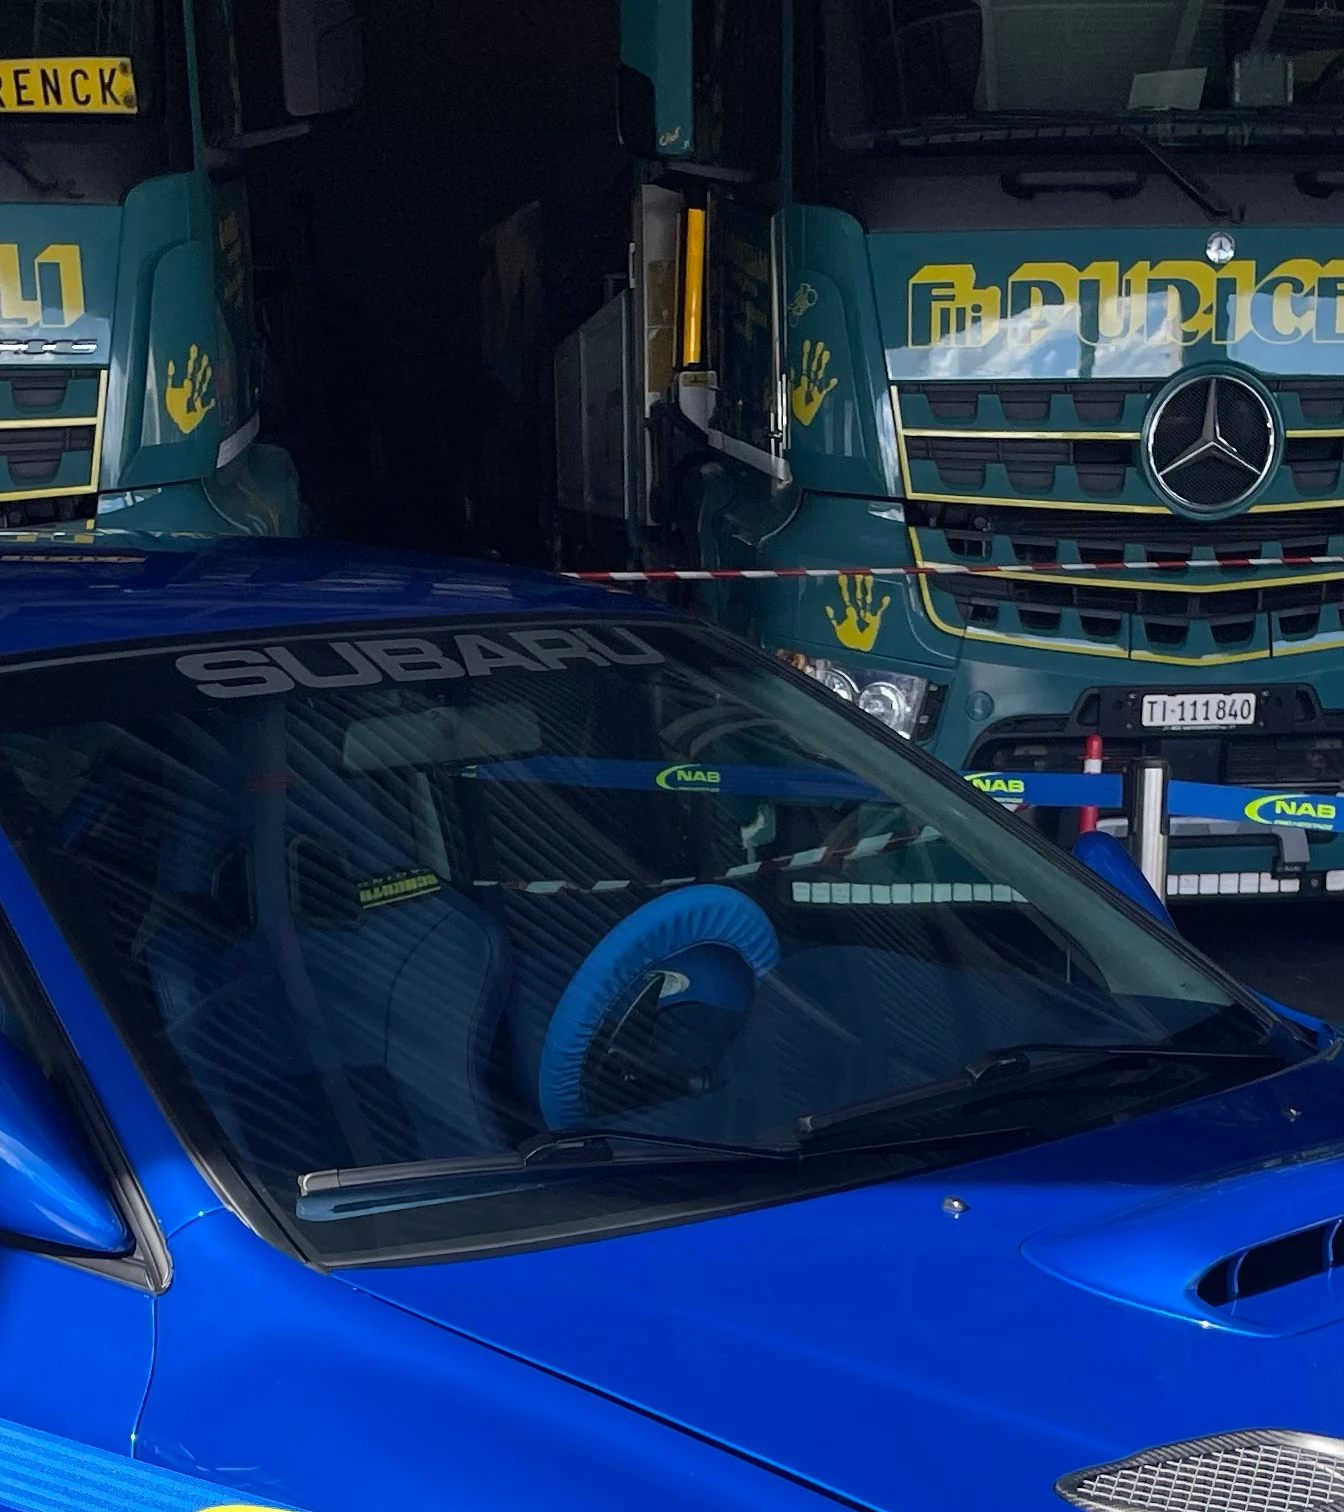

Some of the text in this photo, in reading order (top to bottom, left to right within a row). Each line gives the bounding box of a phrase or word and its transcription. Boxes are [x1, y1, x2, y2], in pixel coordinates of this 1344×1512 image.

[175, 625, 666, 699] SUBARU
[676, 770, 721, 783] NAB
[972, 778, 1025, 793] NAB
[1274, 800, 1336, 819] NAB
